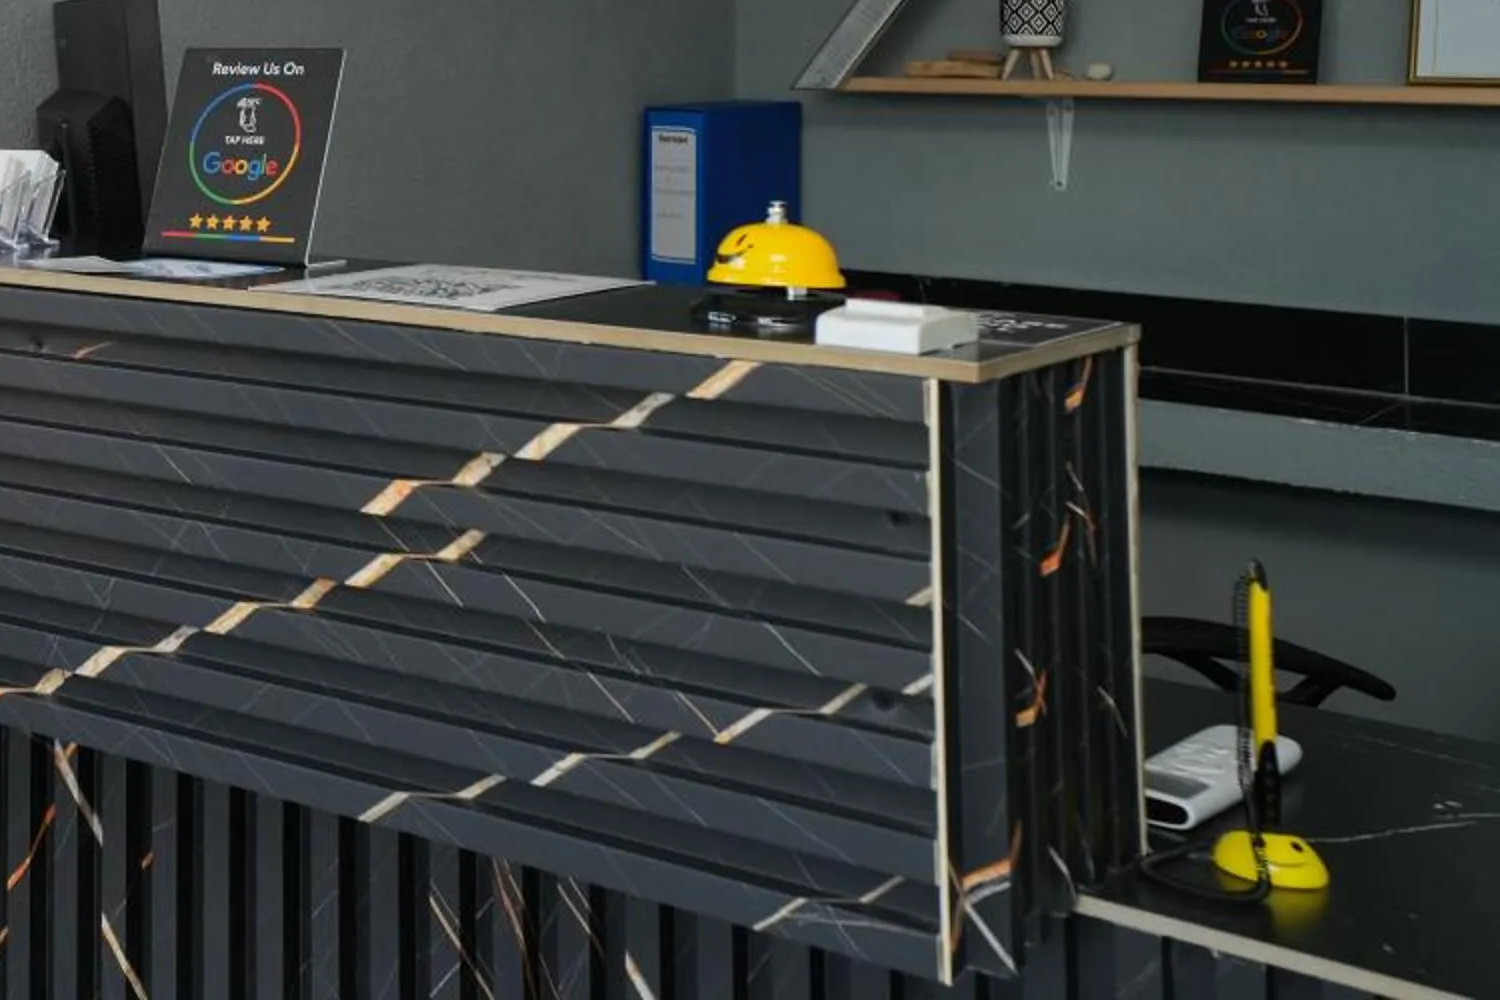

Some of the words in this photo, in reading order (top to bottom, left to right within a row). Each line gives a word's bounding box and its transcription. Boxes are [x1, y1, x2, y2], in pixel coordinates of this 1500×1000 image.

[212, 61, 260, 76] Review
[263, 62, 280, 76] Us
[283, 62, 305, 77] On
[225, 135, 241, 145] TAP
[242, 135, 265, 146] HERE
[203, 151, 280, 181] Google
